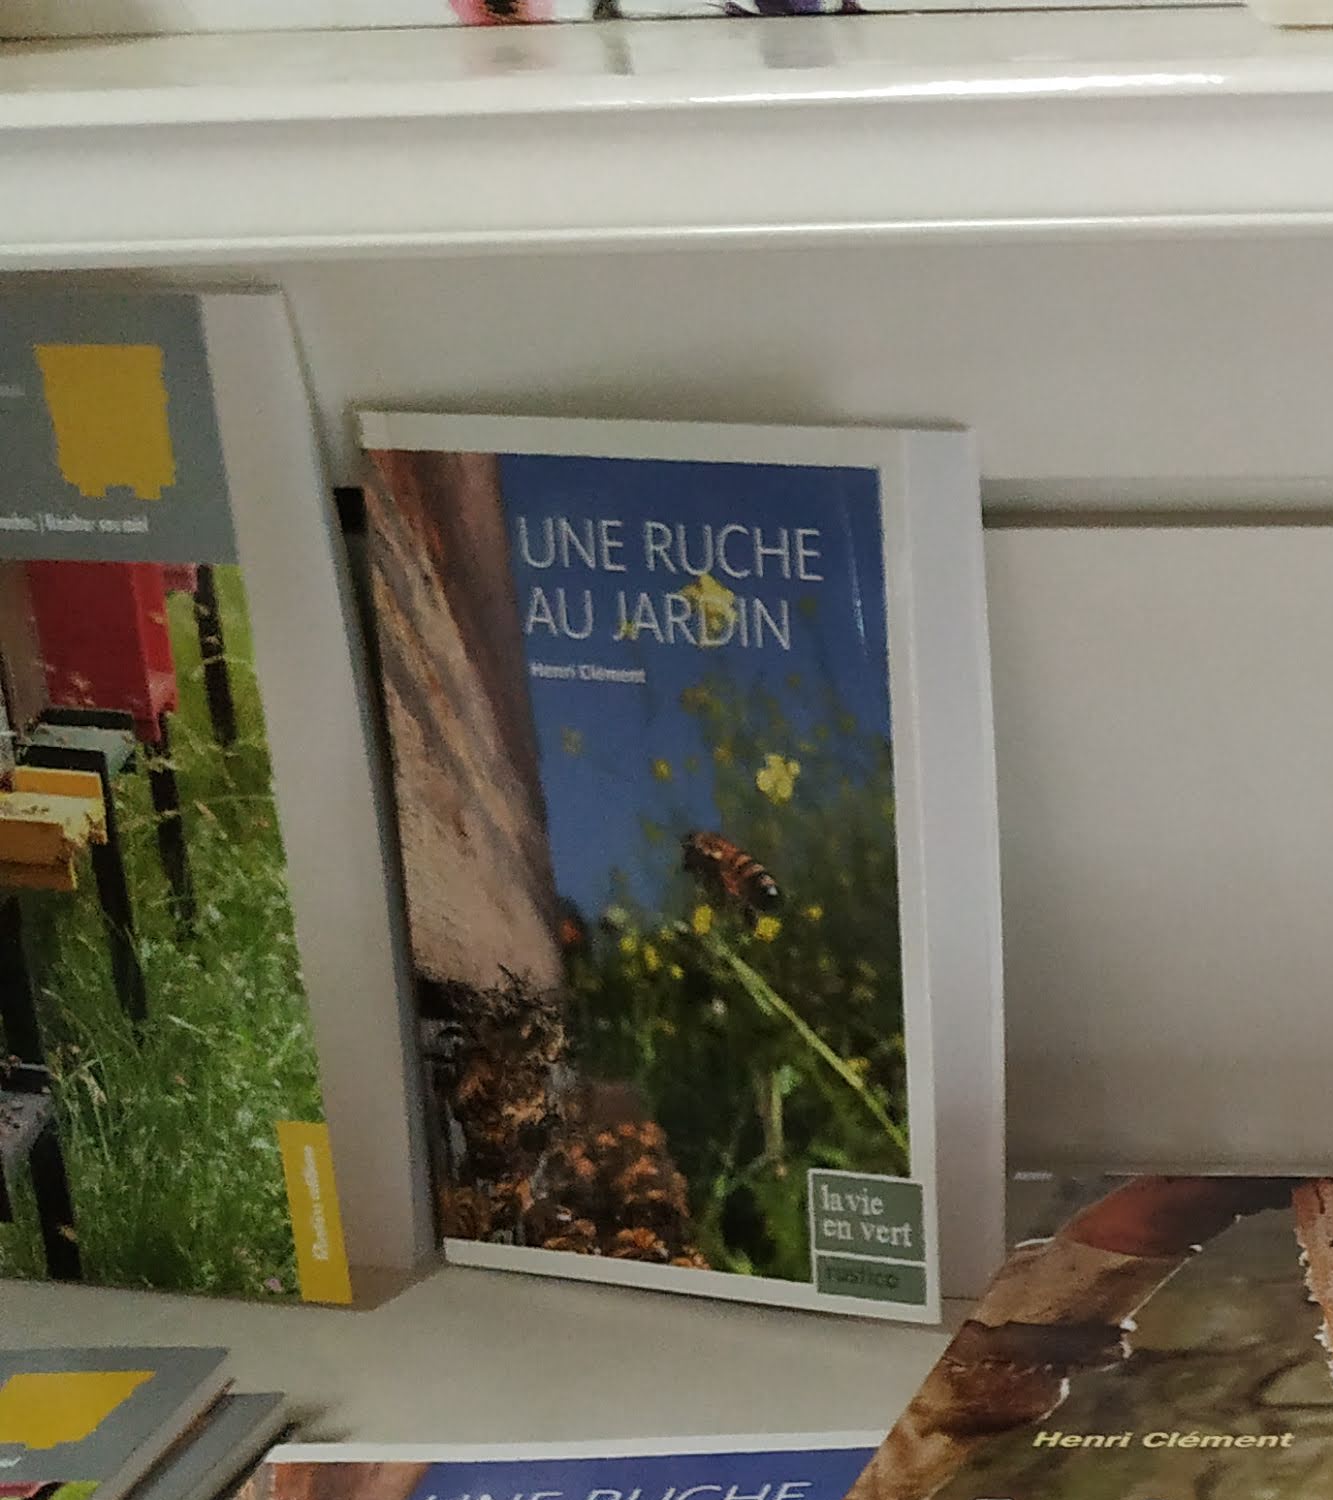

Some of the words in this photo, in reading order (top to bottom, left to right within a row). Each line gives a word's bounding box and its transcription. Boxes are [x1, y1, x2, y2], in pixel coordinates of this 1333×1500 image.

[515, 515, 627, 573] UNE
[644, 521, 826, 582] RUCHE
[527, 586, 594, 640] AU
[612, 592, 793, 651] JARDIN
[820, 1184, 845, 1212] la
[845, 1187, 885, 1217] vie
[822, 1218, 854, 1240] en
[859, 1221, 913, 1249] vert
[1033, 1430, 1139, 1450] Henri
[1146, 1428, 1295, 1450] Clément
